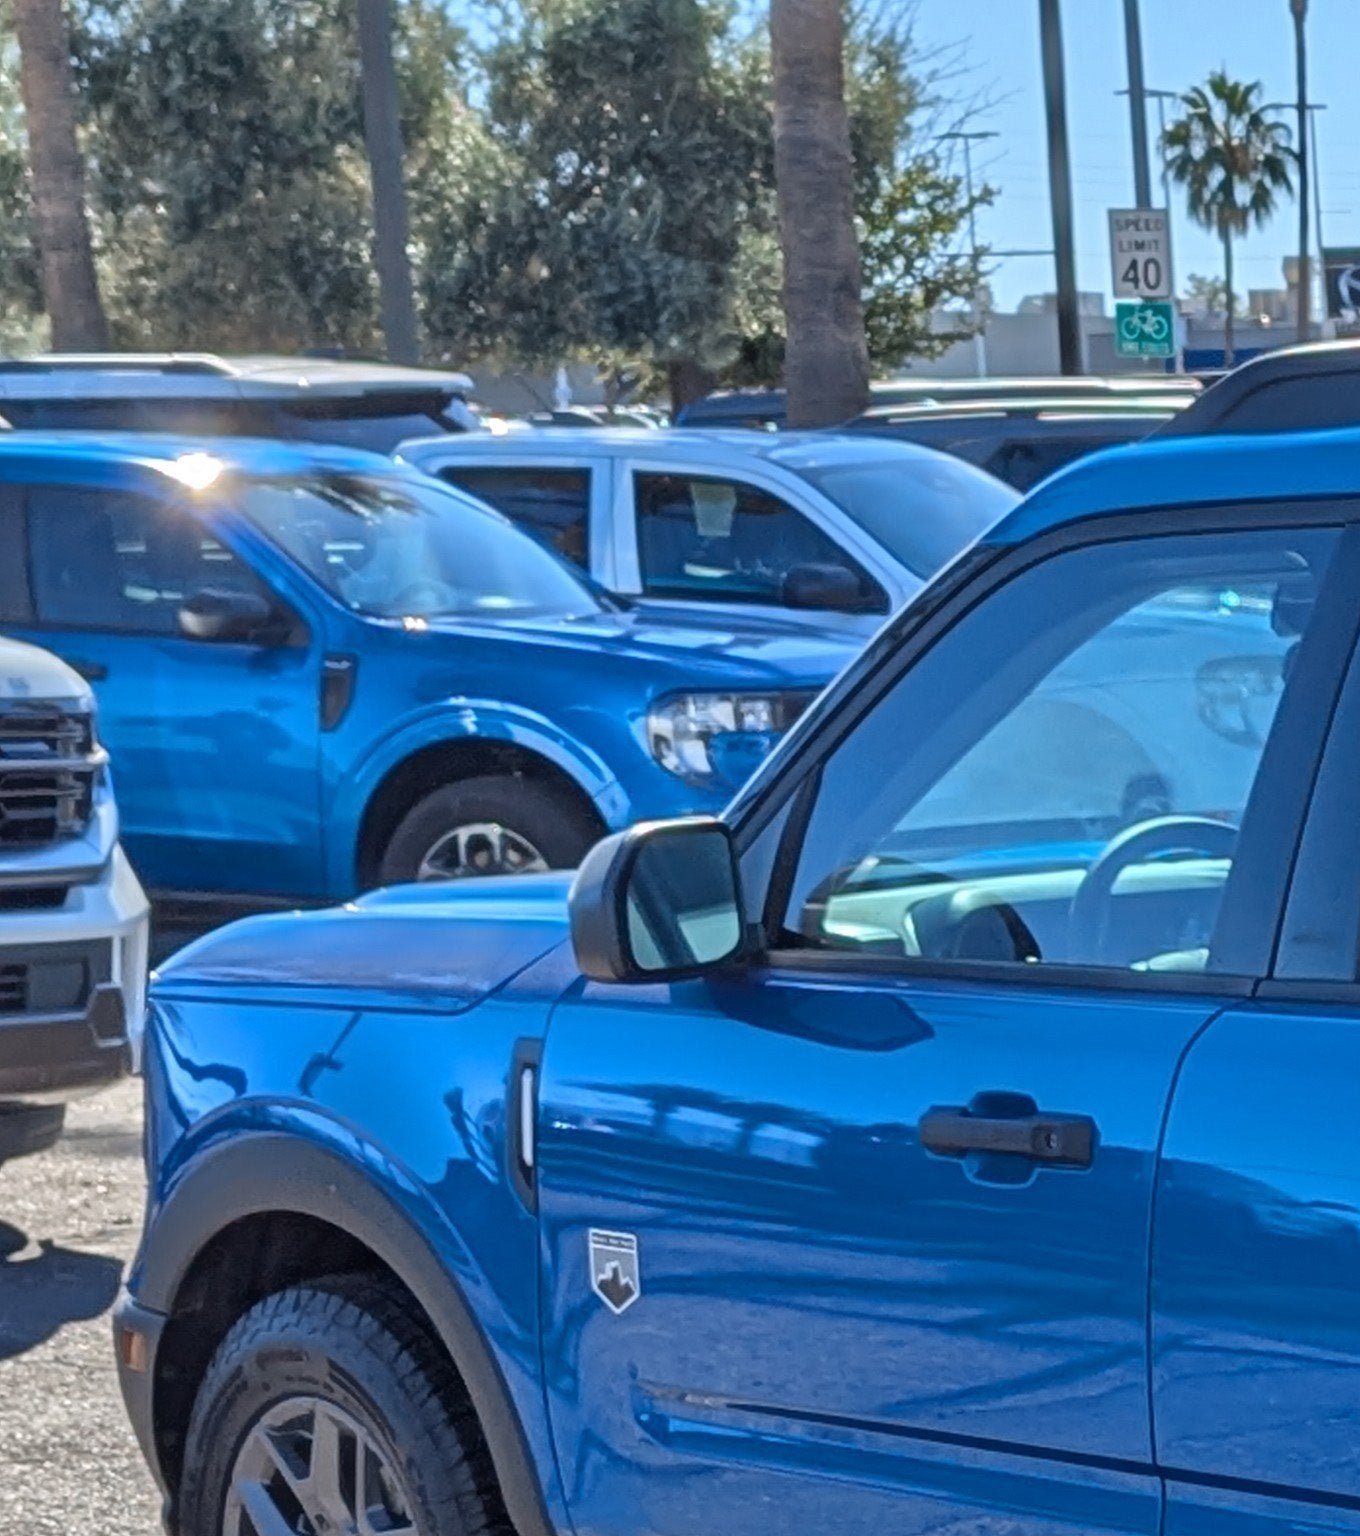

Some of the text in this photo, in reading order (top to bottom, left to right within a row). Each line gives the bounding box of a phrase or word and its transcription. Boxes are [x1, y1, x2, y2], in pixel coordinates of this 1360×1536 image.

[1115, 217, 1164, 232] SPEED
[1118, 239, 1160, 253] LIMIT
[1121, 257, 1162, 291] 40
